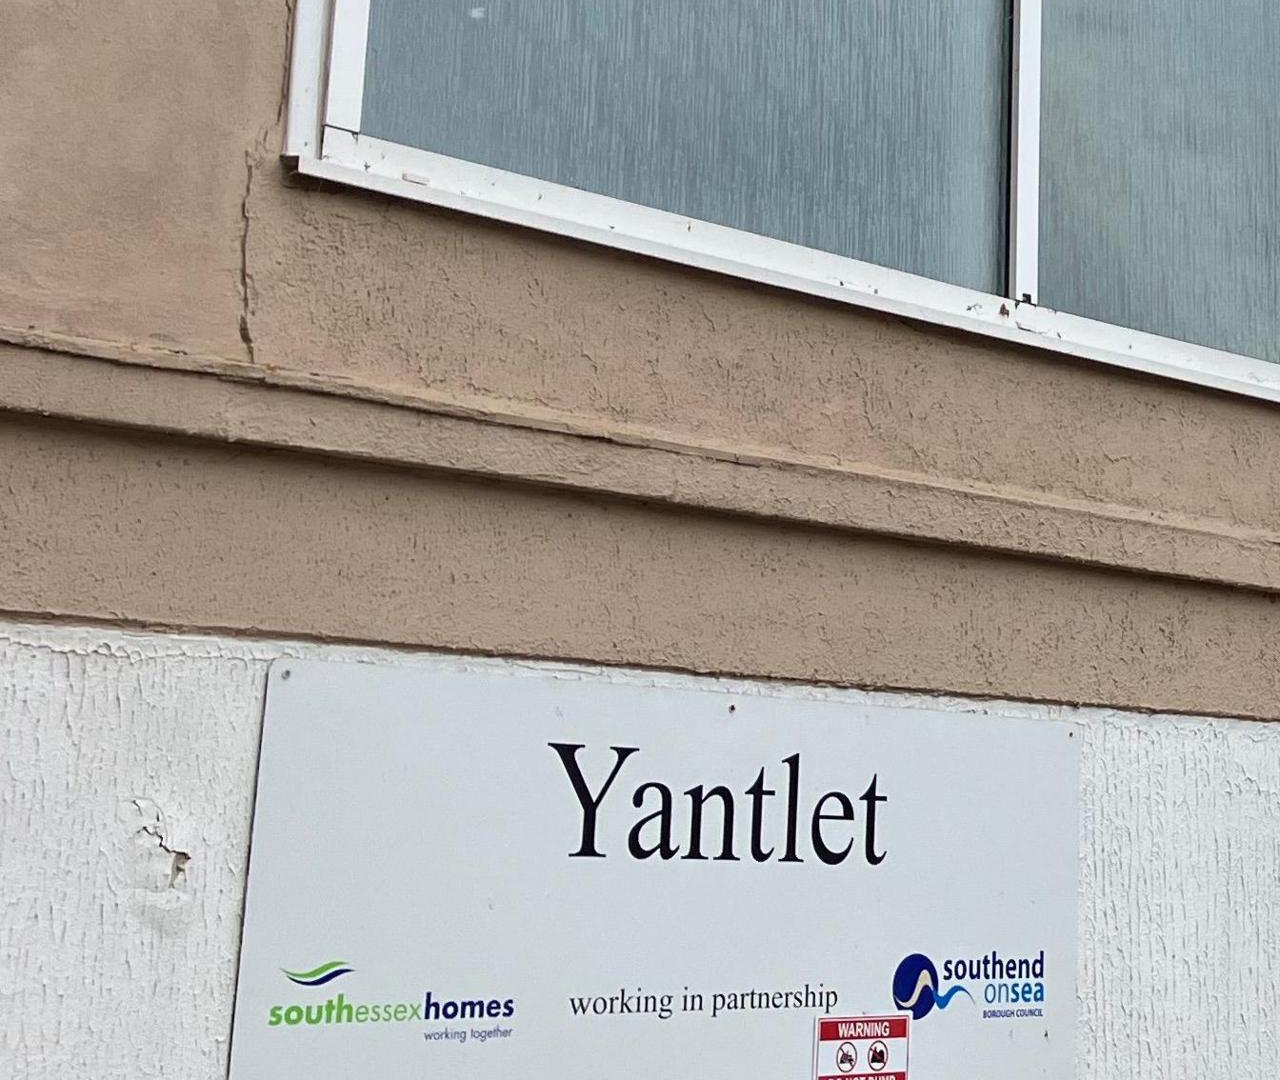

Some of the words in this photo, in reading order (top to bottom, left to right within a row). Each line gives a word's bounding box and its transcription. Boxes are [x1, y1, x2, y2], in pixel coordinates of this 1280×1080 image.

[547, 742, 888, 866] Yantlet
[943, 950, 1044, 980] southend
[569, 988, 674, 1019] working
[682, 986, 703, 1011] in
[711, 983, 838, 1018] partnership
[984, 981, 1044, 1004] onsea
[983, 1009, 1015, 1019] BOROUGH
[1016, 1008, 1044, 1018] COUNCIL
[424, 1027, 467, 1043] working
[470, 1025, 513, 1043] together
[838, 1021, 890, 1038] WARNING
